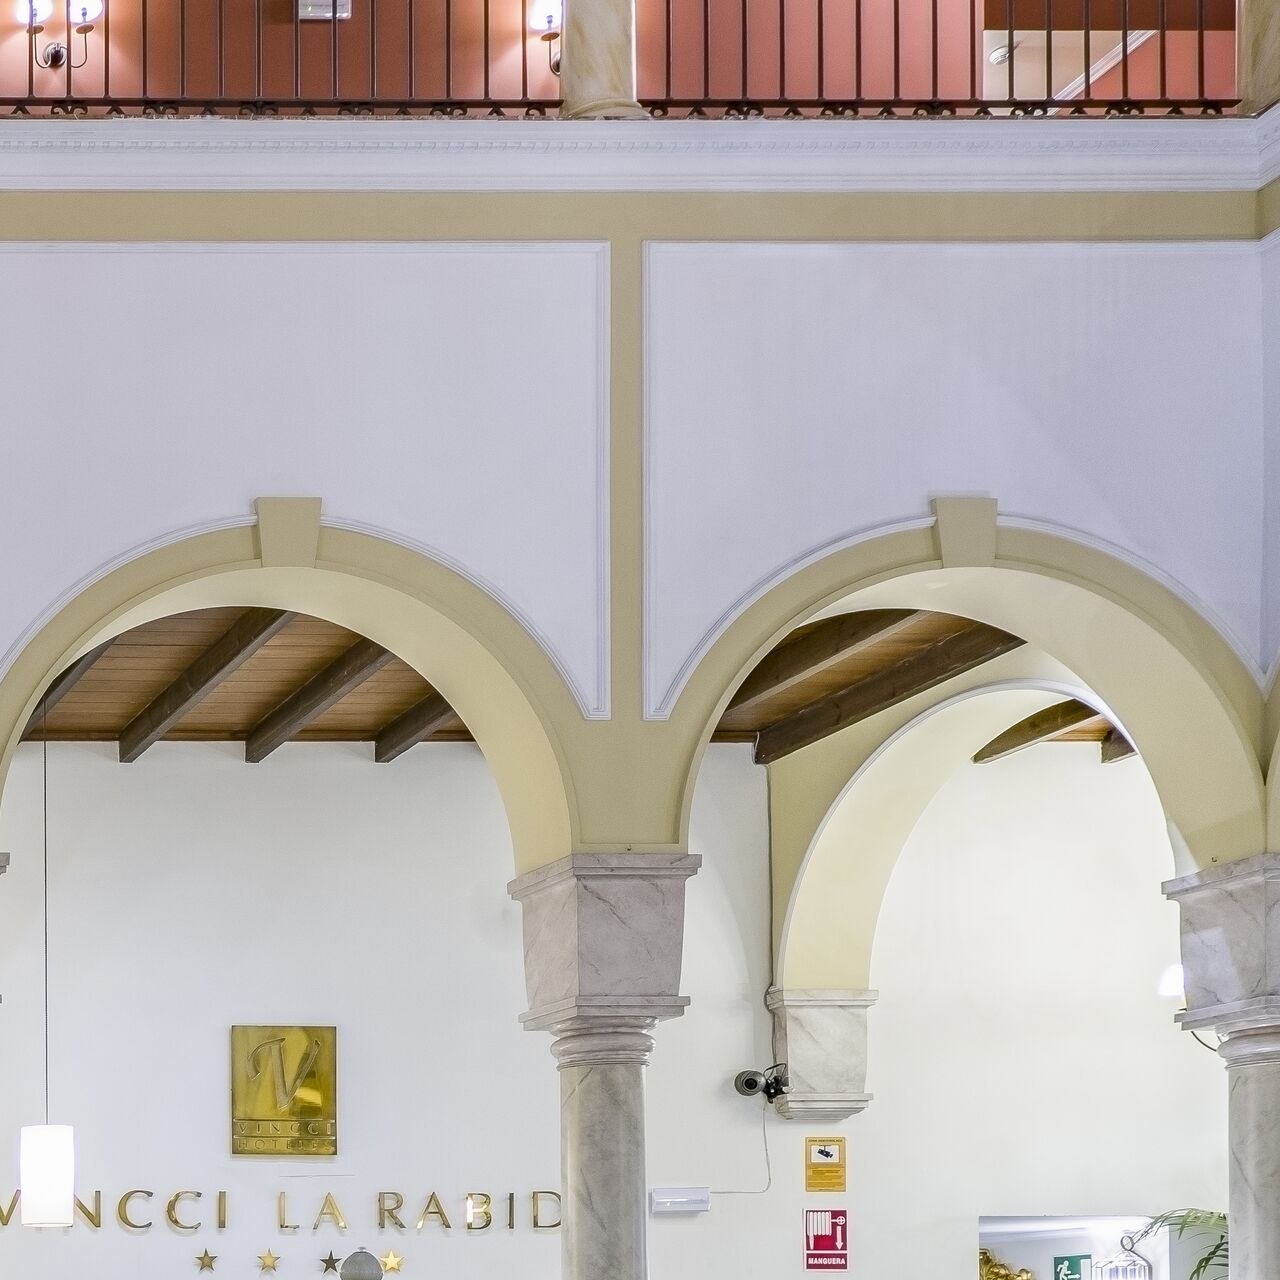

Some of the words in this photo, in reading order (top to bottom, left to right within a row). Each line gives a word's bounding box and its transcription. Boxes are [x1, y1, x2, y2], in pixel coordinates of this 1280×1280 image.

[246, 1037, 321, 1110] V
[237, 1122, 333, 1136] VINCCI
[278, 1191, 348, 1231] LA
[377, 1191, 562, 1231] RABID
[807, 1257, 846, 1265] MANGUERA
